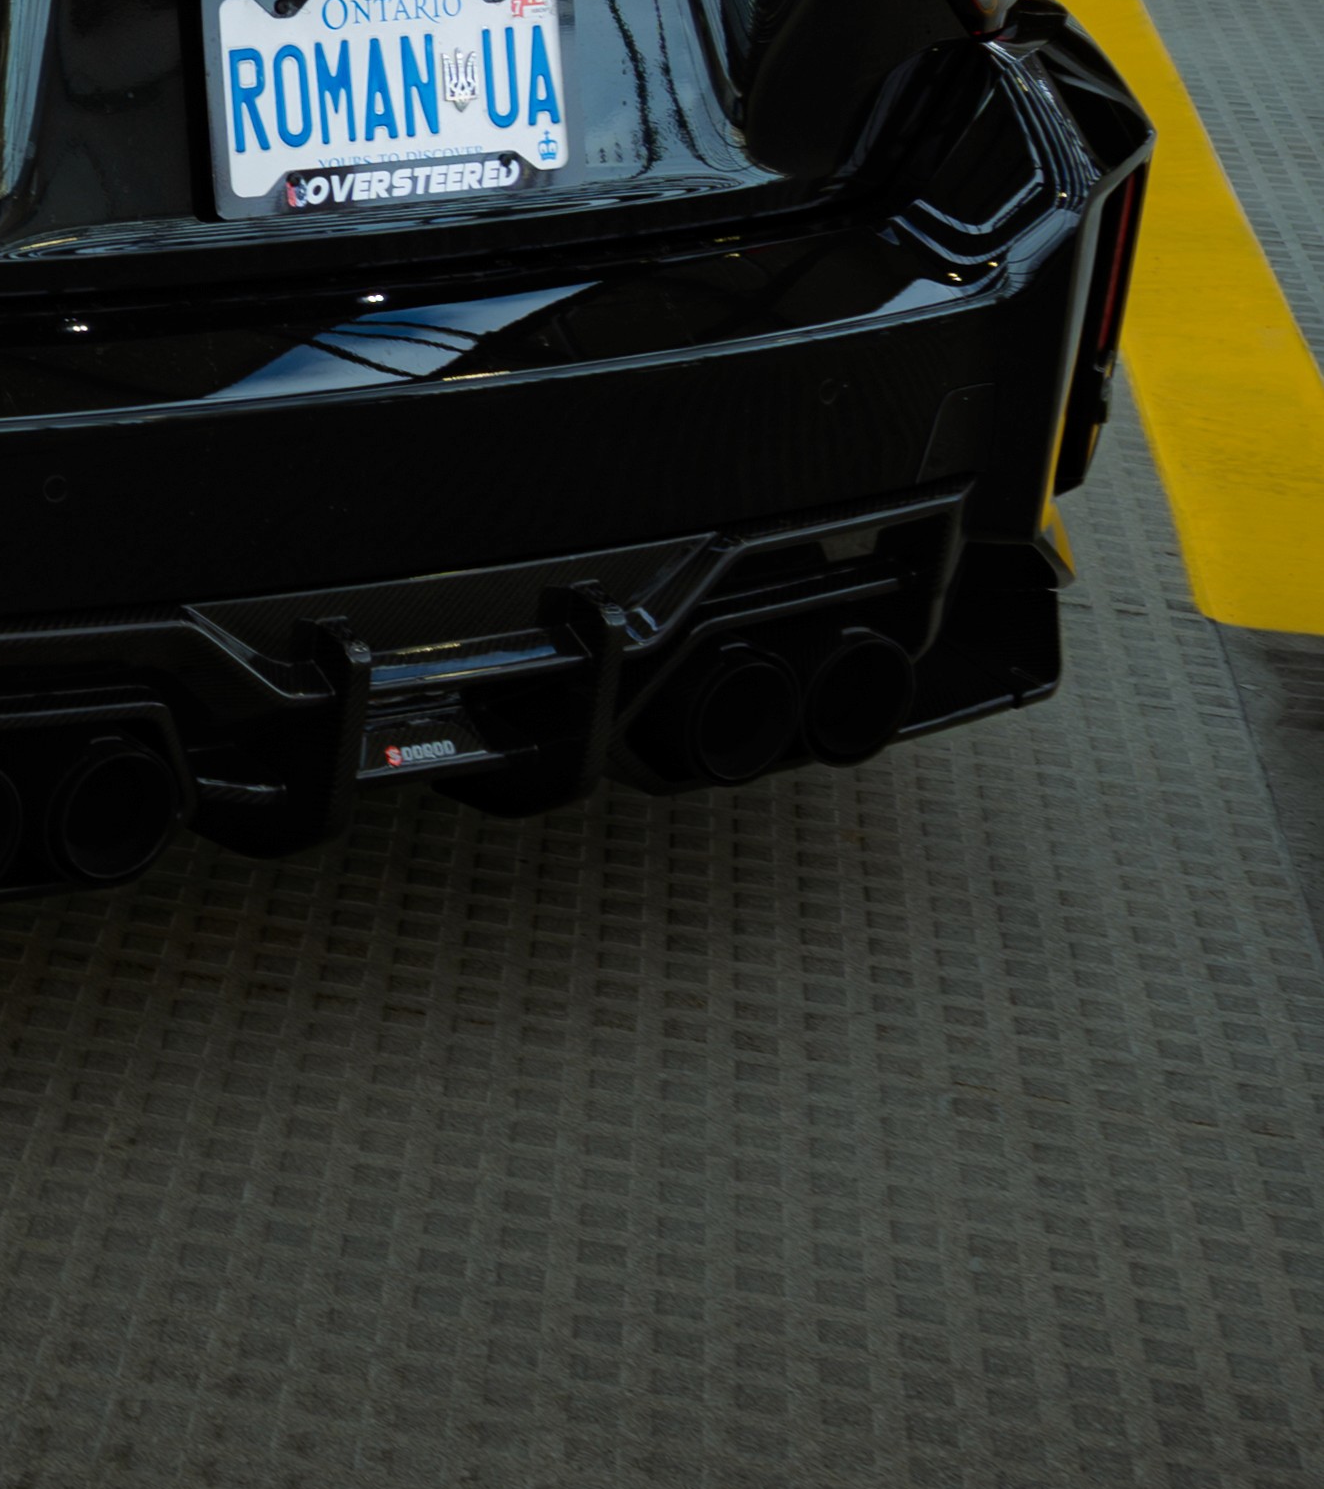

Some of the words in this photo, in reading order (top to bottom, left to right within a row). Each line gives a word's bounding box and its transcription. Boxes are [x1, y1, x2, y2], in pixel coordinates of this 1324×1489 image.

[228, 33, 440, 153] ROMAN
[482, 25, 561, 128] UA
[306, 159, 520, 205] OVERSTEERED
